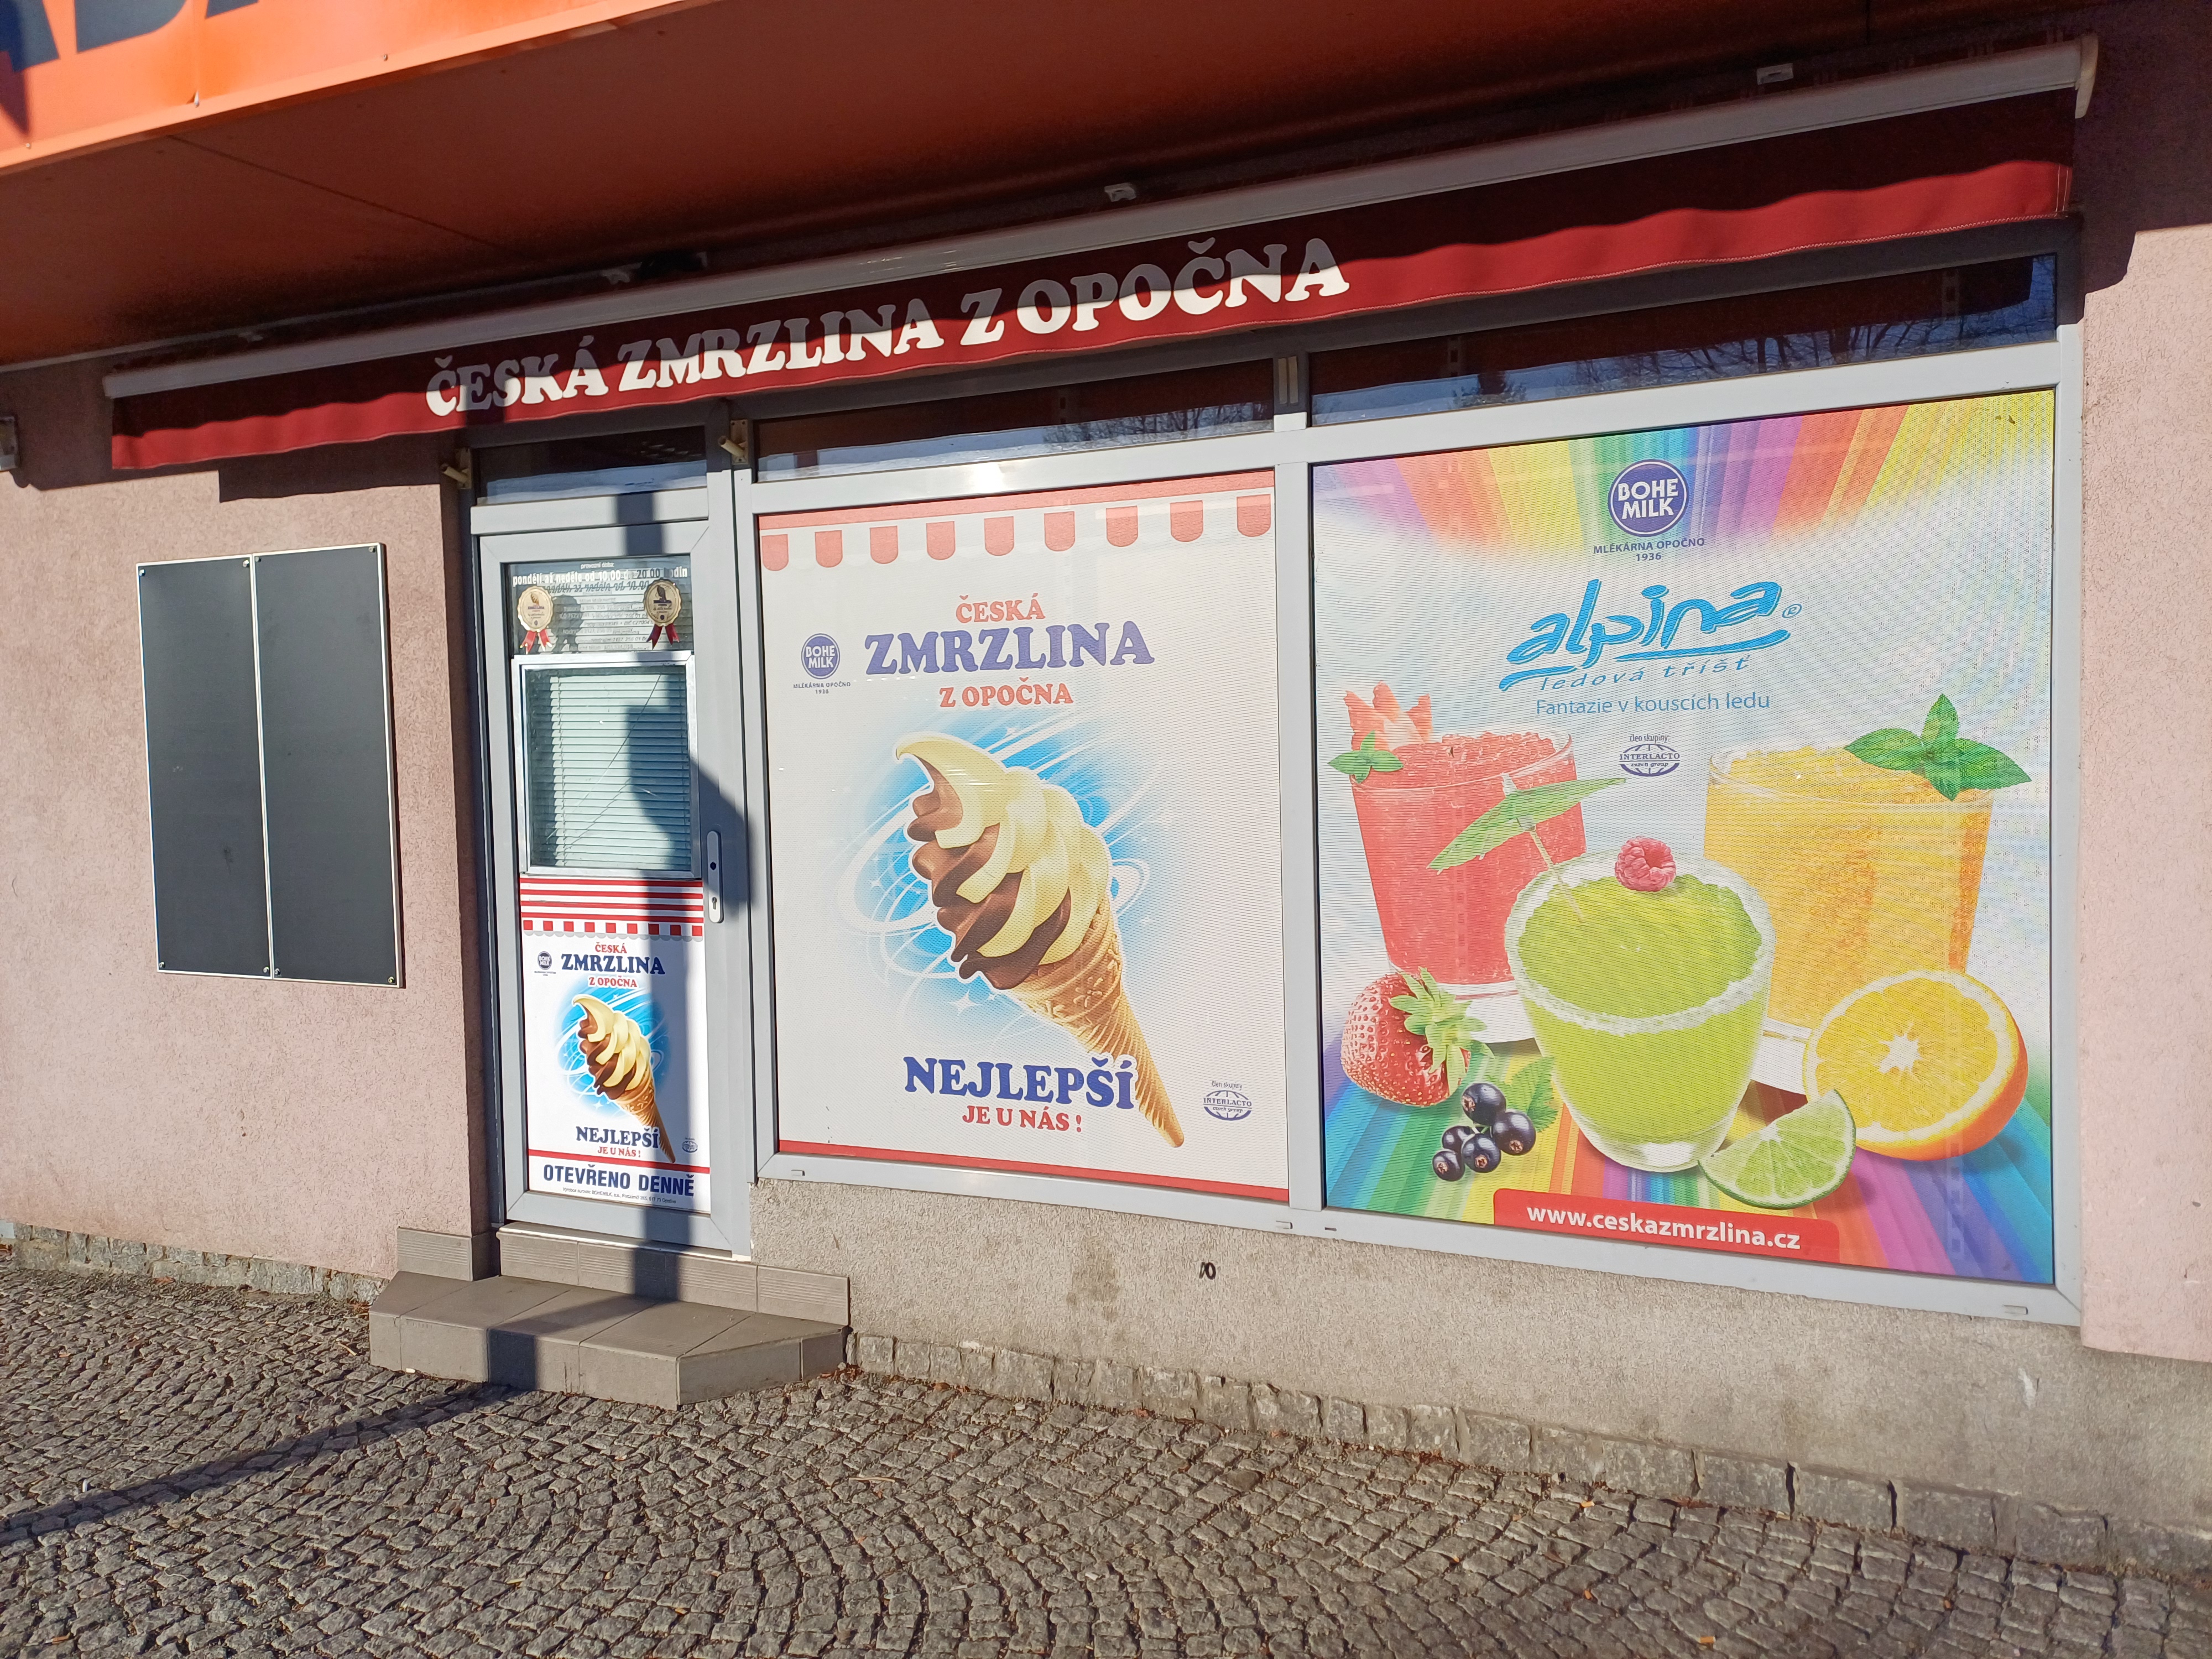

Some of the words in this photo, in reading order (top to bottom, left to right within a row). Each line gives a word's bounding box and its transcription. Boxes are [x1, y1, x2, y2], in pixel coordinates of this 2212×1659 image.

[426, 335, 609, 416] ČESKÁ
[618, 298, 945, 393] ZMRZLINA
[960, 288, 1005, 346] Z
[1016, 237, 1350, 335] OPOČNA
[1618, 478, 1679, 502] BOHE
[1621, 497, 1675, 520] MILK
[1593, 540, 1653, 555] MLÉKÁRNA
[1656, 536, 1705, 550] OPOČNO
[1635, 552, 1662, 562] 1936
[956, 593, 1046, 624] ČESKÁ
[864, 620, 1155, 675] ZMRZLINA
[808, 656, 834, 669] MILK
[1540, 669, 1645, 691] ledová
[940, 687, 956, 708] Z
[962, 676, 1074, 707] OPOČNA
[1536, 697, 1613, 716] Fantazie
[1618, 701, 1630, 713] v
[1635, 693, 1719, 712] kouscích
[1725, 691, 1770, 710] ledu
[594, 942, 627, 953] ČESKÁ
[561, 953, 665, 975] ZMRZLINA
[588, 977, 596, 986] Z
[598, 975, 637, 987] OPOČNA
[903, 1056, 1135, 1110] NEJLEPŠÍ
[1203, 1097, 1252, 1107] INTERLACTO
[962, 1105, 990, 1126] JE
[995, 1107, 1014, 1128] U
[576, 1126, 659, 1149] NEJLEPŠÍ
[597, 1145, 609, 1155] JE
[610, 1146, 618, 1155] U
[544, 1164, 630, 1189] OTEVŘENO
[638, 1173, 695, 1197] DENNĚ
[1526, 1206, 1801, 1250] www.ceskazmrzlina.cz
